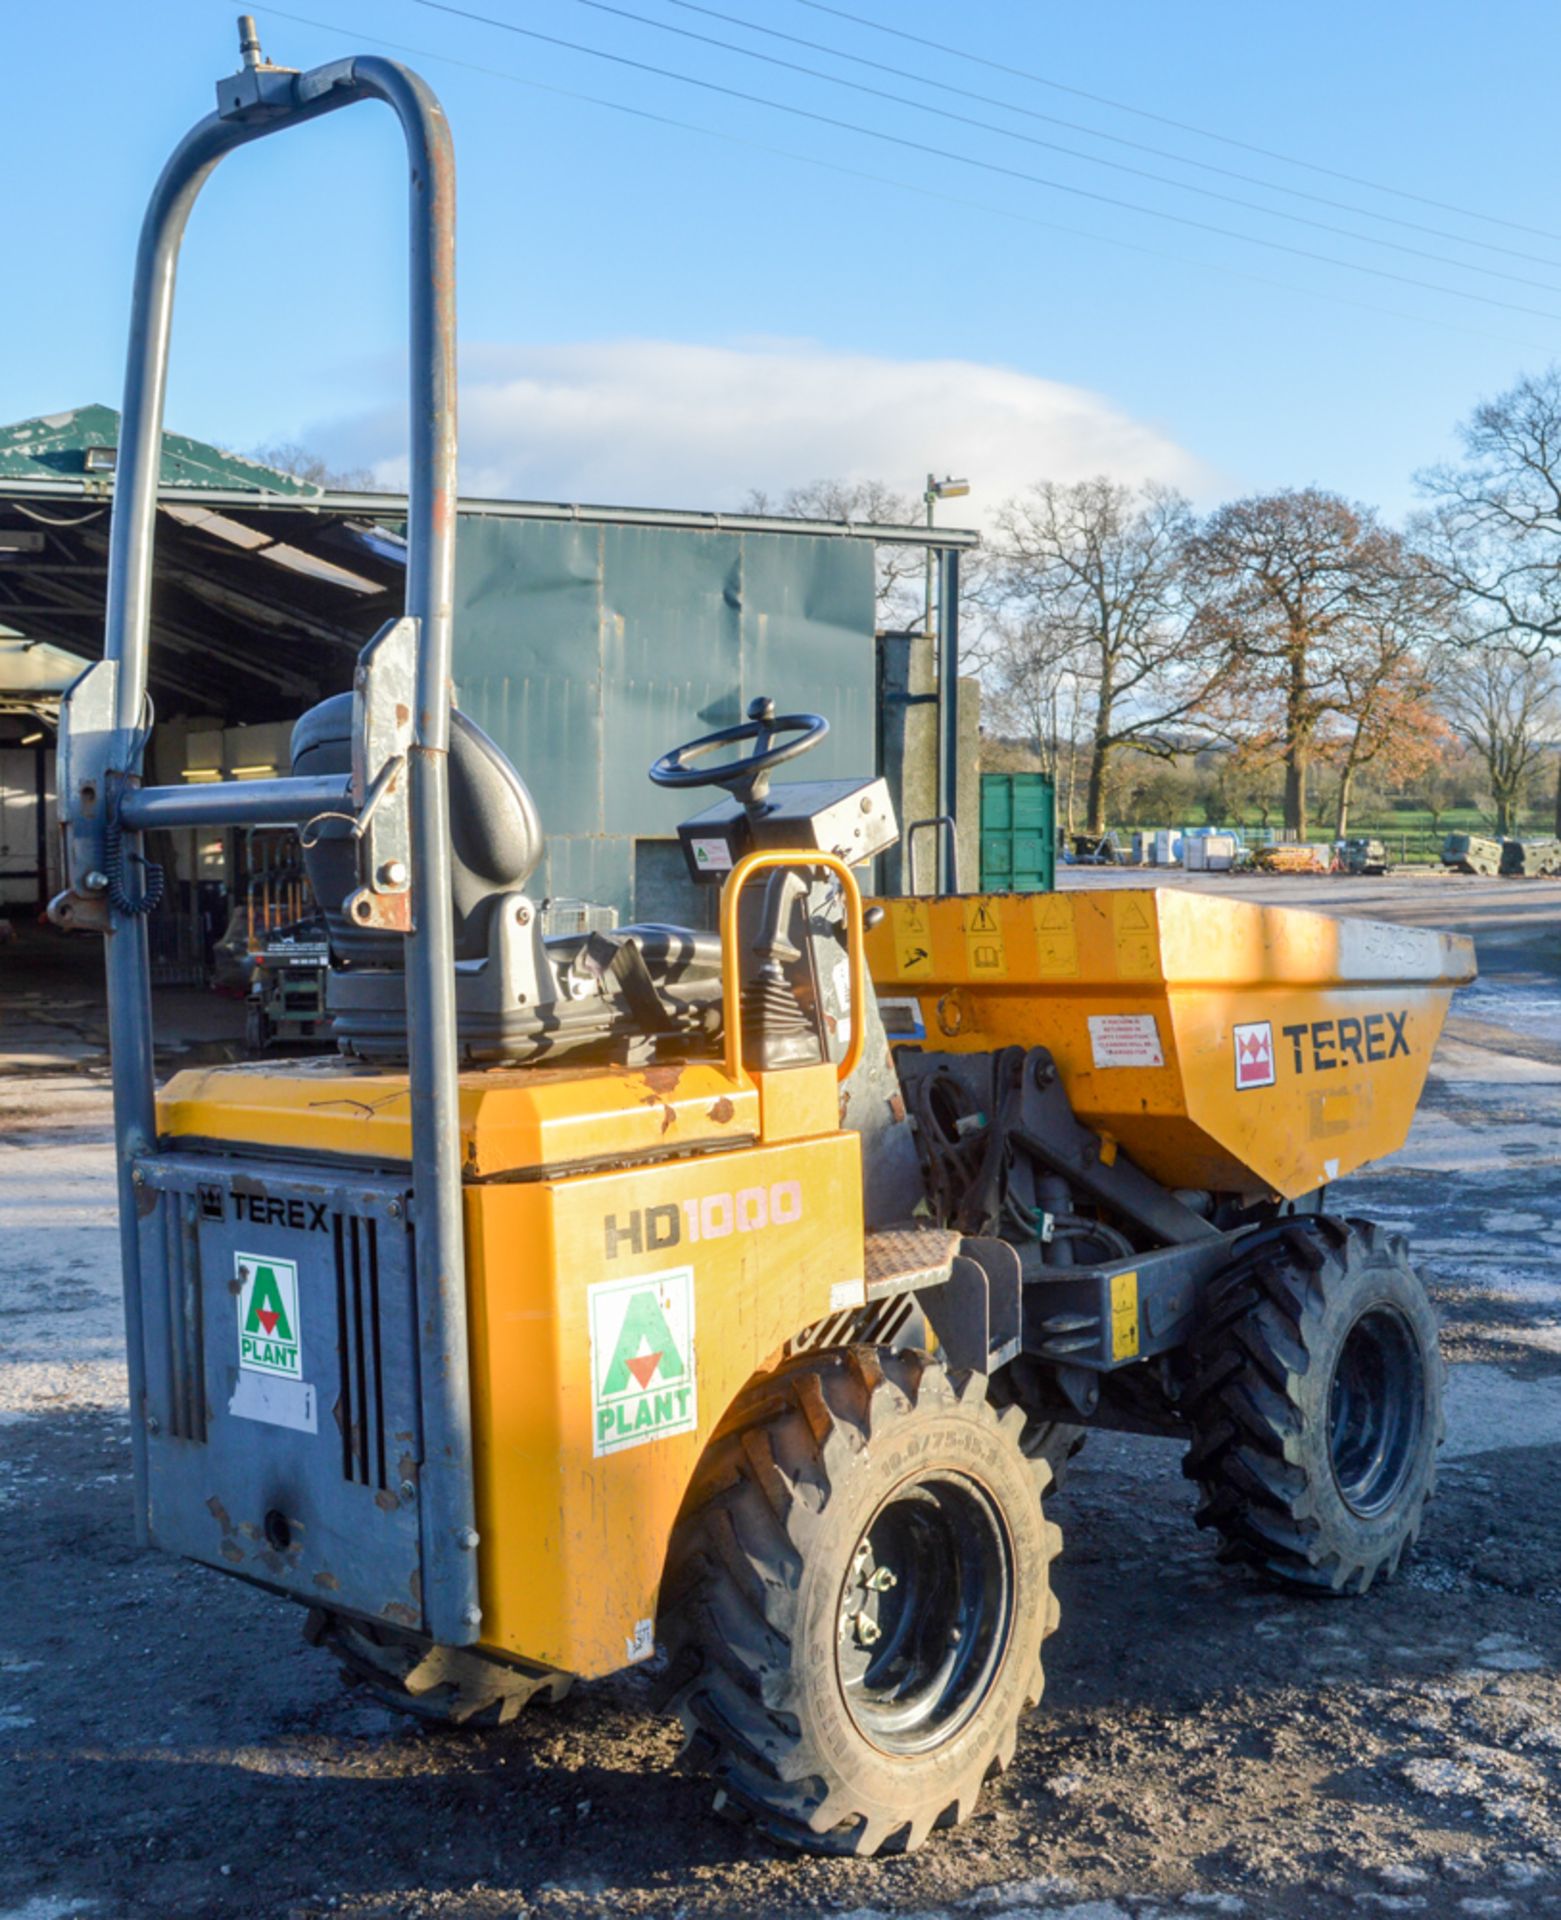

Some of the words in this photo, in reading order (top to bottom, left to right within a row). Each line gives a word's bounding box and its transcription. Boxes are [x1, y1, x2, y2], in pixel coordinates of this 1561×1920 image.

[1282, 1010, 1411, 1074] TEREX
[230, 1193, 329, 1233] TEREX
[604, 1180, 802, 1260] HD1000
[245, 1266, 293, 1340] A
[241, 1337, 299, 1369] PLANT
[601, 1290, 685, 1396] A
[597, 1387, 692, 1441] PLANT
